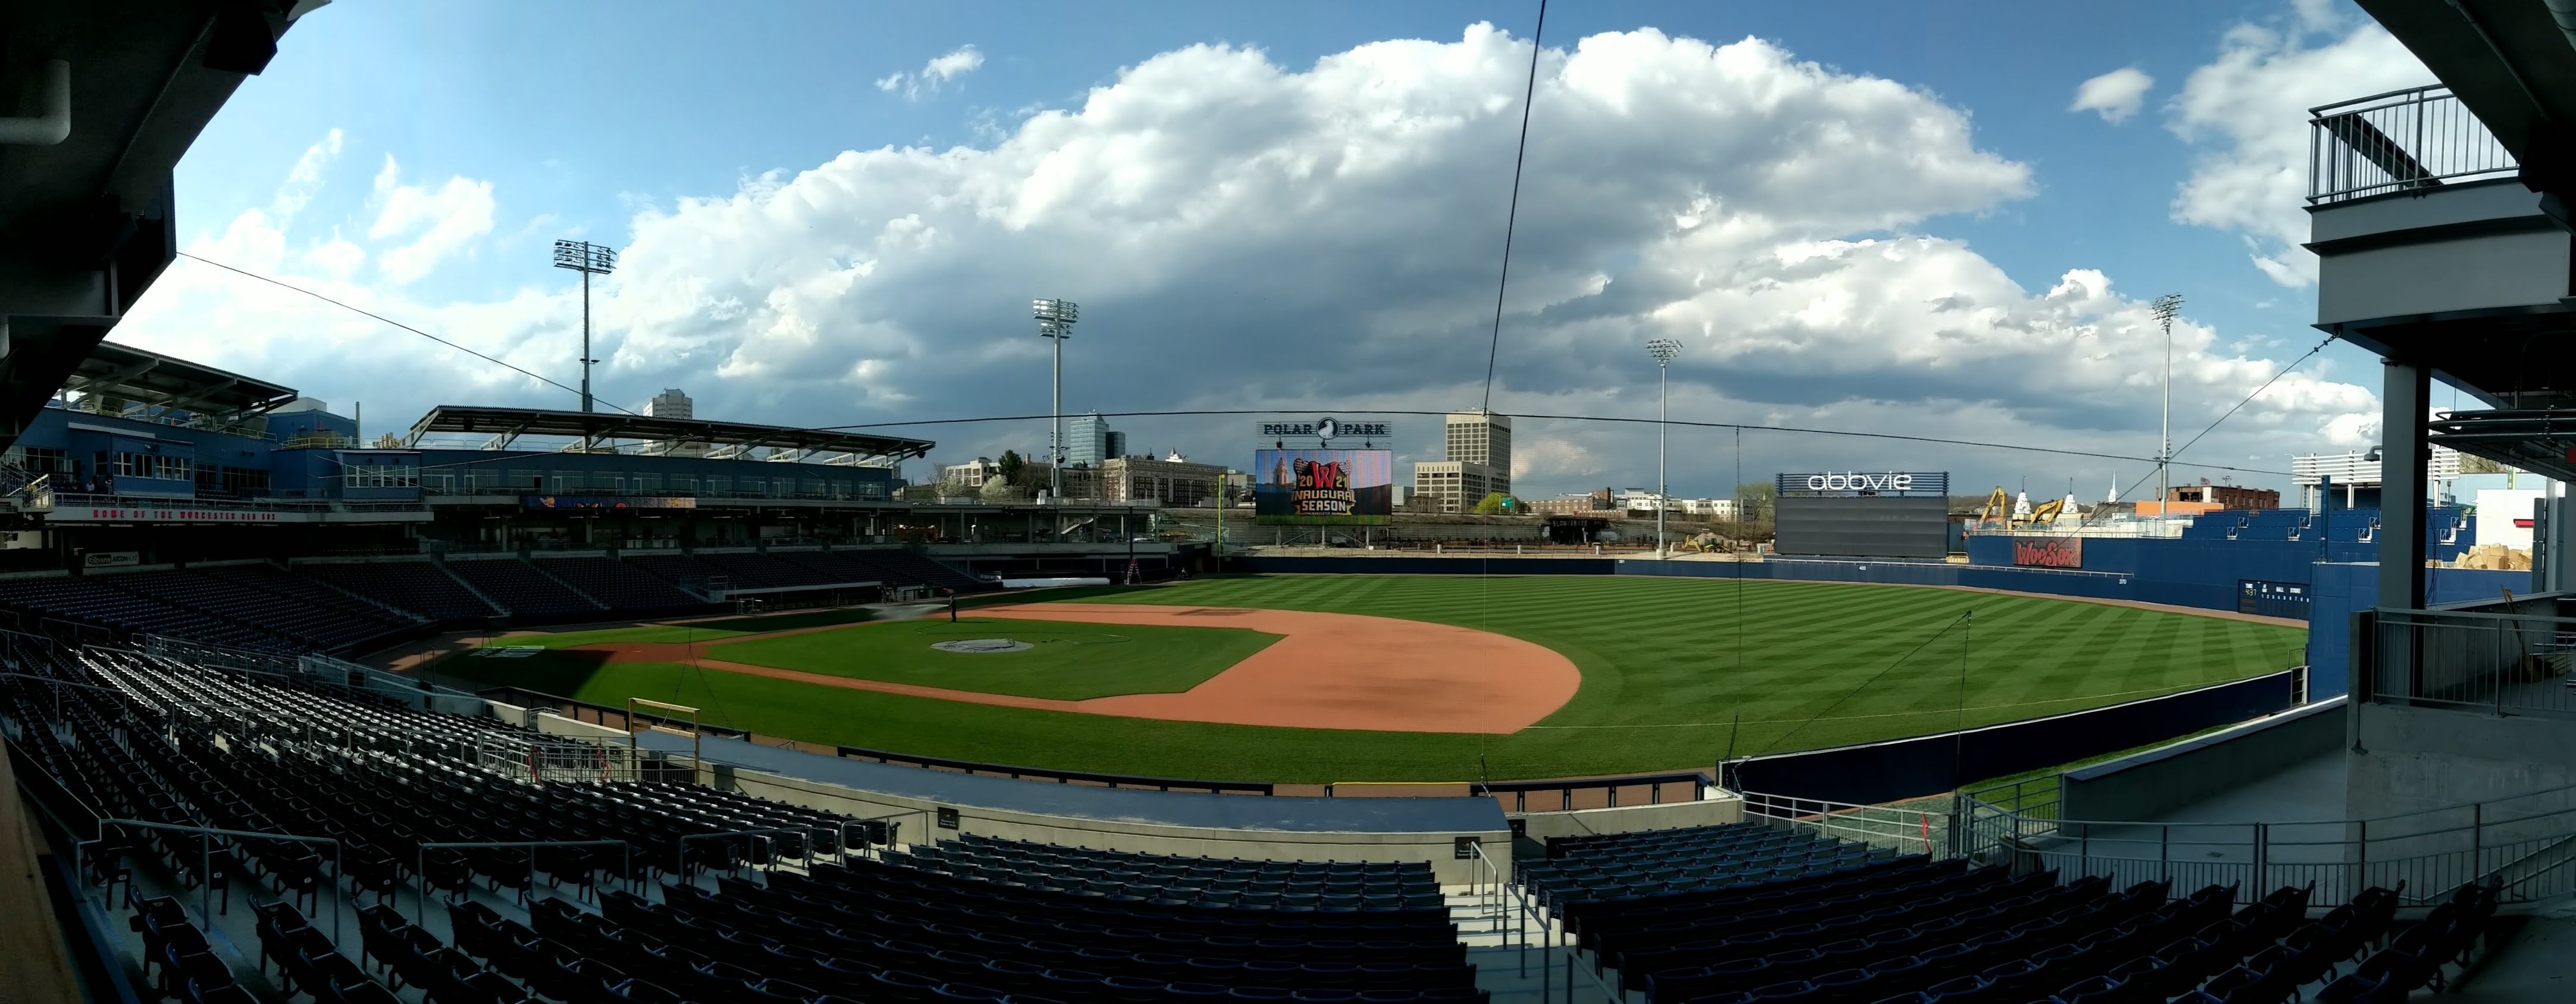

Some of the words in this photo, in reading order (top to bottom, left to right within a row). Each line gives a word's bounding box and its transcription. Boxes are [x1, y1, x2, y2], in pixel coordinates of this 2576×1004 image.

[1264, 424, 1312, 434] POLAR
[1344, 424, 1384, 434] PARK
[1299, 475, 1313, 487] 20
[1336, 476, 1347, 487] 21
[1808, 470, 1912, 490] abbvie
[1291, 489, 1356, 503] INAUGURAL
[1302, 500, 1346, 511] SEASON
[93, 509, 124, 518] HOME
[153, 511, 173, 519] THE
[180, 511, 236, 520] WORCESTER
[2016, 542, 2077, 567] WooSox
